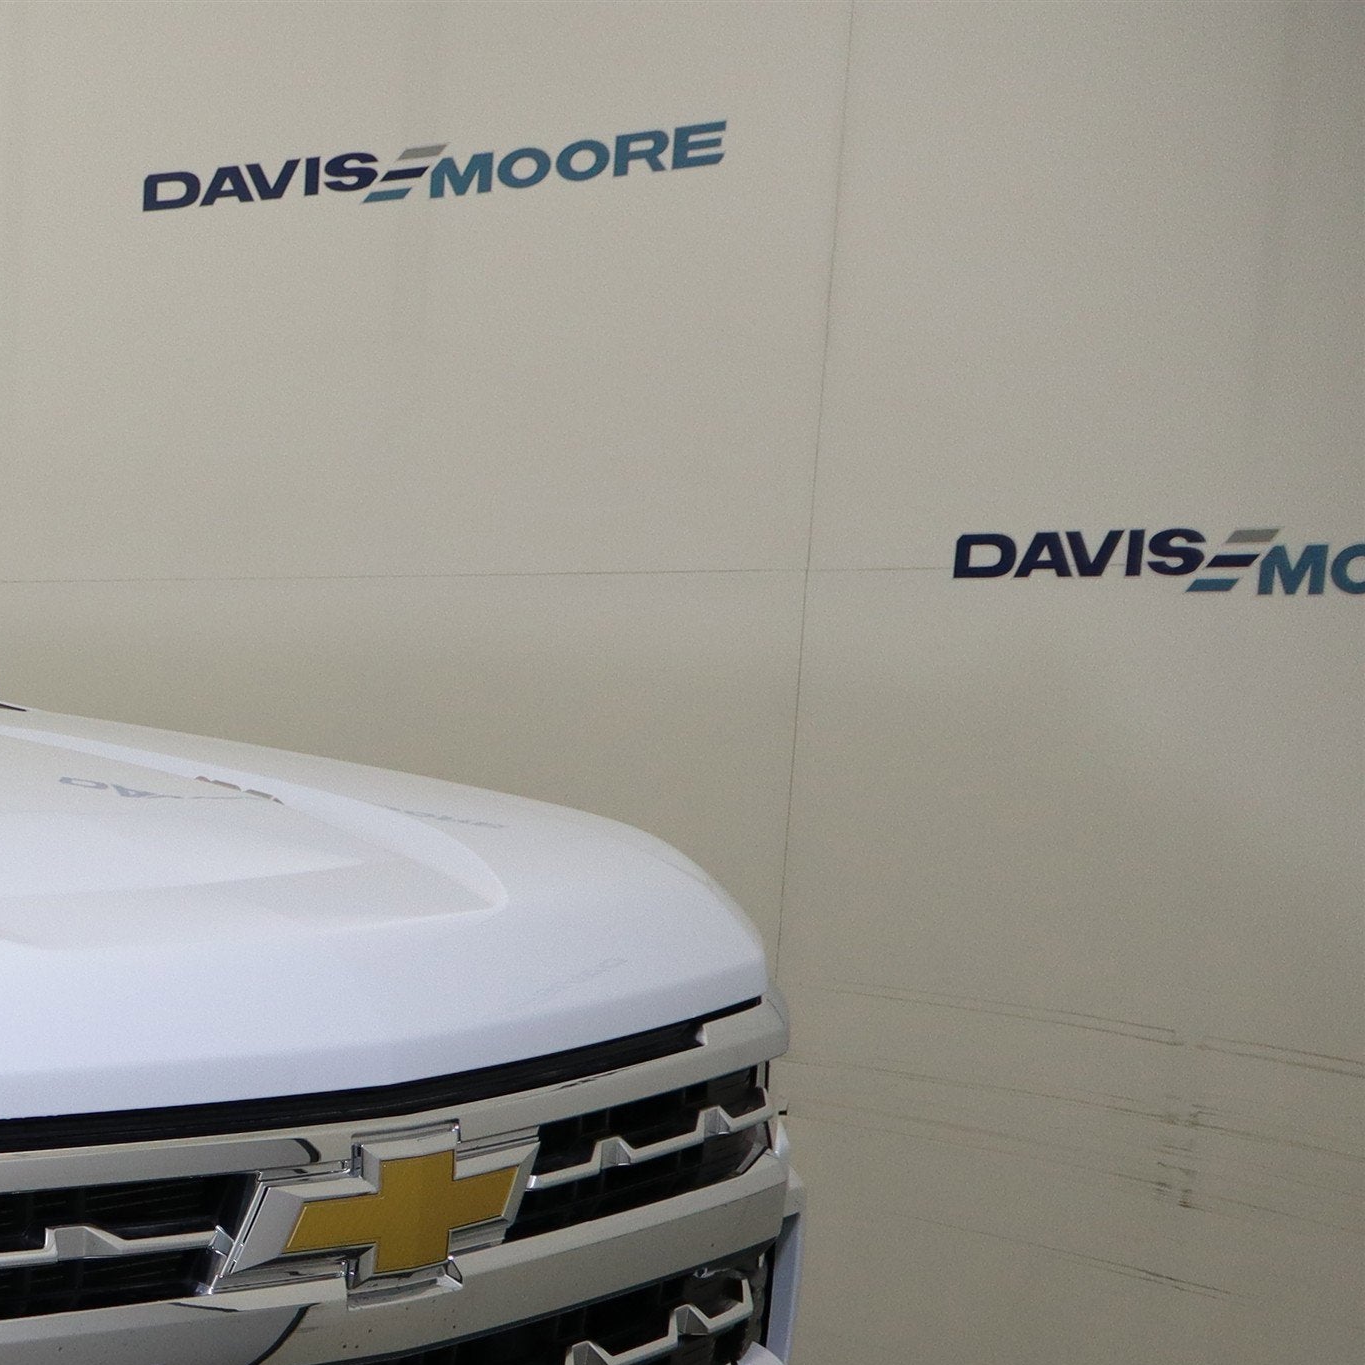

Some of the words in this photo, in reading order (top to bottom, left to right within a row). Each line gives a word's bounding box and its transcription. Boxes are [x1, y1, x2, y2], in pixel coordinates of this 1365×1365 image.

[142, 151, 379, 212] DAVIS
[429, 120, 727, 199] MOORE
[952, 527, 1206, 579] DAVIS
